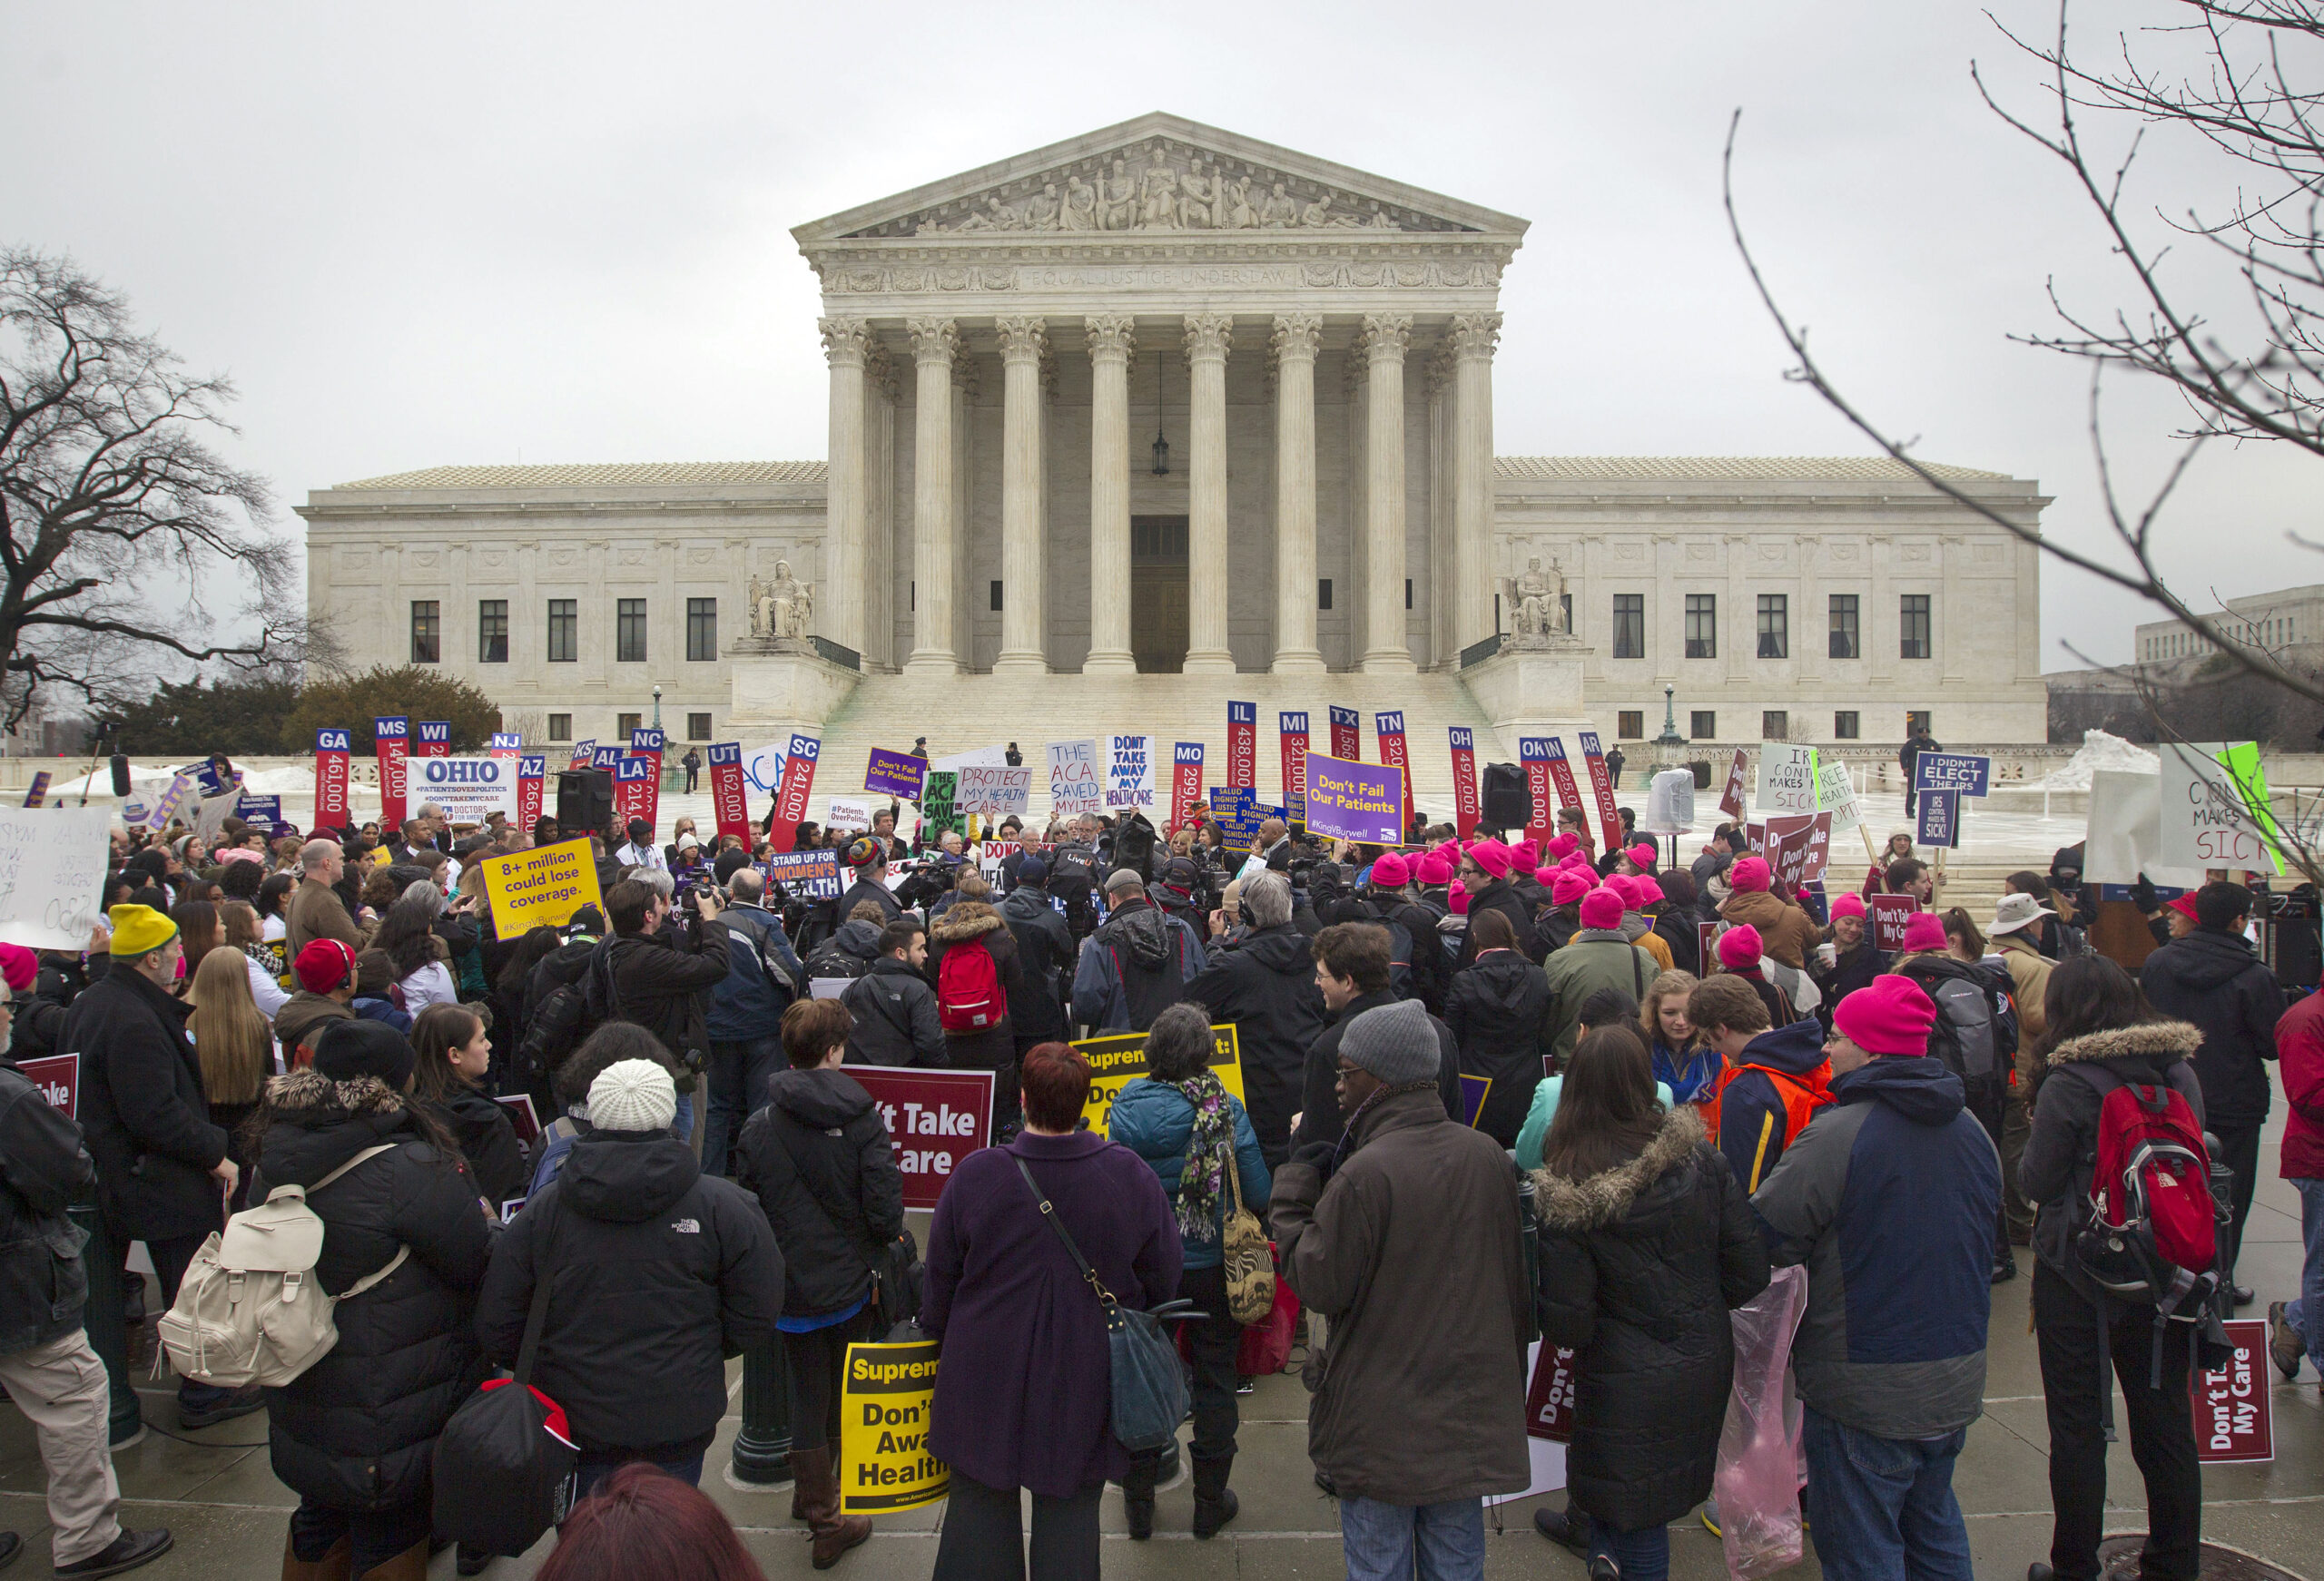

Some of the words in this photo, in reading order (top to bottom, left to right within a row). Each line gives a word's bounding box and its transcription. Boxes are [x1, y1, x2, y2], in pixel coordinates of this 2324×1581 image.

[1031, 271, 1093, 286] EQUAL
[1098, 270, 1172, 285] JUSTICE
[1181, 269, 1244, 284] UNDER
[1249, 269, 1286, 284] LAW
[1234, 704, 1251, 722] IL
[1331, 708, 1357, 726] TX
[378, 721, 406, 735] MS
[1282, 714, 1305, 732] MI
[1377, 713, 1403, 732] TN
[320, 732, 348, 749] GA
[421, 725, 447, 741] WI
[494, 735, 519, 748] NJ
[634, 732, 661, 748] NC
[1451, 731, 1472, 746] OH
[575, 741, 594, 758] KS
[791, 738, 818, 758] SC
[1051, 744, 1089, 762] THE
[1339, 728, 1355, 760] 1,566
[1521, 741, 1545, 757] OK
[1543, 740, 1562, 758] IN
[1582, 736, 1600, 752] AR
[595, 750, 616, 766] AL
[711, 745, 738, 762] UT
[1114, 751, 1146, 764] TAKE
[1177, 747, 1202, 761] MO
[1236, 727, 1252, 787] 438,000
[1789, 749, 1810, 765] IR
[389, 741, 407, 799] 147,000
[426, 760, 499, 782] OHIO
[520, 759, 543, 776] AZ
[619, 761, 645, 779] LA
[877, 759, 900, 771] Don't
[901, 764, 917, 774] Fail
[1050, 762, 1094, 782] ACA
[1110, 764, 1147, 778] AWAY
[1290, 737, 1305, 794] 321,000
[1774, 764, 1812, 779] CONT
[1930, 758, 1935, 766] I
[1937, 759, 1978, 769] DIDN'T
[326, 754, 343, 812] 461,000
[870, 767, 886, 776] Our
[887, 771, 921, 784] Patients
[930, 772, 954, 783] THE
[961, 768, 1031, 786] PROTECT
[1818, 765, 1846, 789] REE
[1925, 766, 1982, 782] ELECT
[785, 762, 811, 822] 241,000
[1051, 782, 1098, 800] SAVED
[1118, 777, 1142, 790] MY
[1319, 774, 1355, 794] Don't
[1359, 782, 1384, 797] Fail
[1460, 752, 1475, 815] 497,000
[1592, 760, 1616, 822] 128,000
[1769, 778, 1803, 789] MAKES
[1930, 779, 1952, 788] THE
[1955, 781, 1974, 790] IRS
[722, 767, 743, 821] 162,000
[964, 788, 987, 799] MY
[989, 788, 1027, 801] HEALTH
[1311, 789, 1333, 805] Our
[1337, 795, 1395, 813] Patients
[1531, 764, 1547, 829] 208,000
[1775, 791, 1816, 810] SICK
[1932, 796, 1943, 808] IRS
[454, 805, 488, 814] DOCTORS
[524, 781, 539, 834] 266,00
[832, 805, 864, 815] #Patients
[964, 800, 1014, 813] CARE
[1249, 802, 1275, 813] SALUD
[1832, 800, 1861, 825] OPTI
[1928, 808, 1946, 816] CONTROL
[831, 813, 868, 824] OverPolitics
[1224, 822, 1246, 830] SALUD
[2192, 809, 2240, 827] MAKES
[1311, 819, 1368, 838] #KingVBurwell
[1380, 833, 1397, 842] SEIU
[1925, 823, 1946, 839] SICK!
[501, 863, 522, 876] 8+
[527, 852, 576, 870] million
[773, 854, 803, 866] STAND
[803, 853, 816, 863] UP
[817, 851, 836, 862] FOR
[1067, 853, 1092, 867] LiveU
[1782, 843, 1808, 867] Don't
[773, 862, 836, 880] WOMEN'S
[1785, 867, 1802, 884] My
[505, 872, 547, 892] could
[550, 869, 579, 882] lose
[509, 886, 582, 908] coverage.
[503, 909, 571, 933] #KingVBurwell
[1876, 907, 1897, 924] Don't
[1898, 908, 1909, 923] Tak
[1883, 924, 1896, 941] My
[1081, 1049, 1146, 1070] Suprem
[903, 1102, 976, 1136] Take
[852, 1358, 940, 1385] Suprem
[2230, 1347, 2251, 1398] Care
[1539, 1346, 1575, 1424] Don't
[2207, 1389, 2231, 1449] Don't
[2232, 1401, 2259, 1434] My
[875, 1430, 930, 1454] Awa
